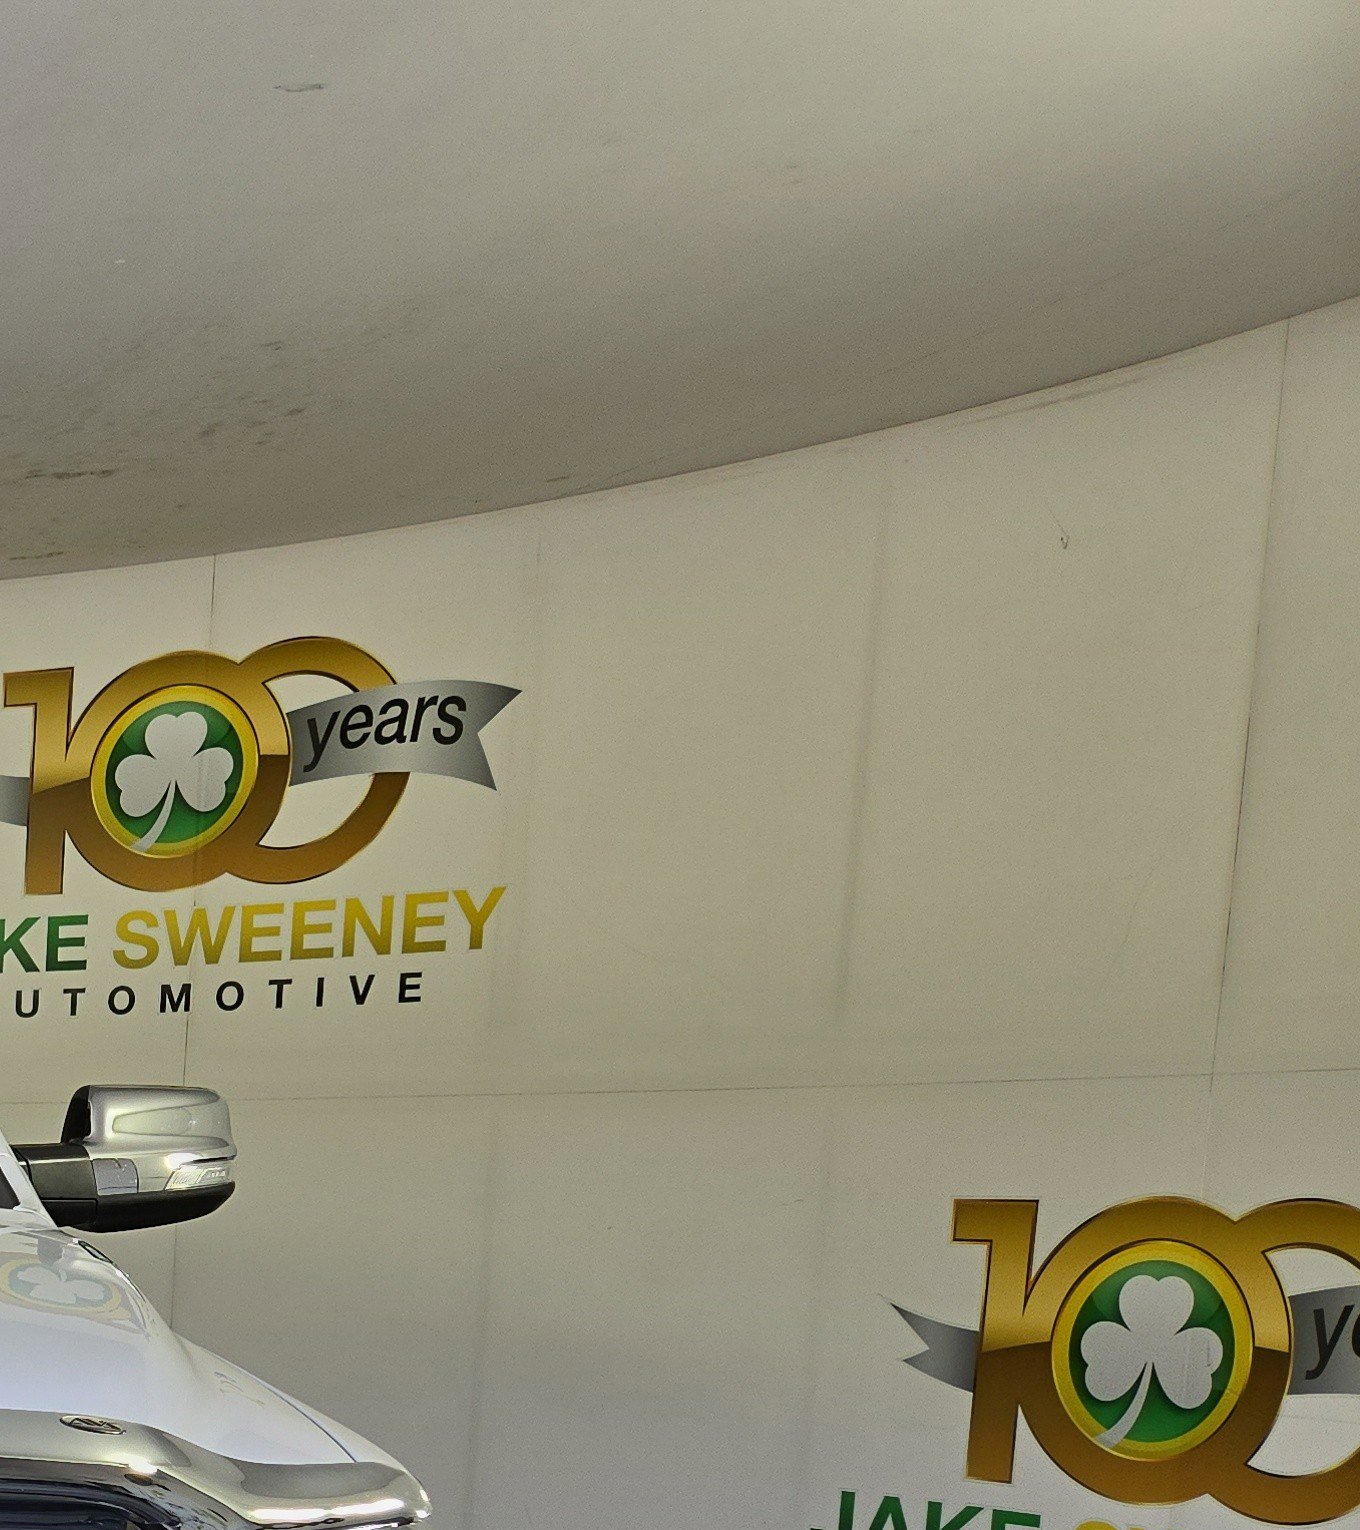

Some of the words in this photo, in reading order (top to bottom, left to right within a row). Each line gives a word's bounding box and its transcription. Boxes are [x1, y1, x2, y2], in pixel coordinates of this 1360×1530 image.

[302, 690, 467, 773] years
[113, 886, 507, 969] SWEENEY
[1305, 1303, 1360, 1381] y
